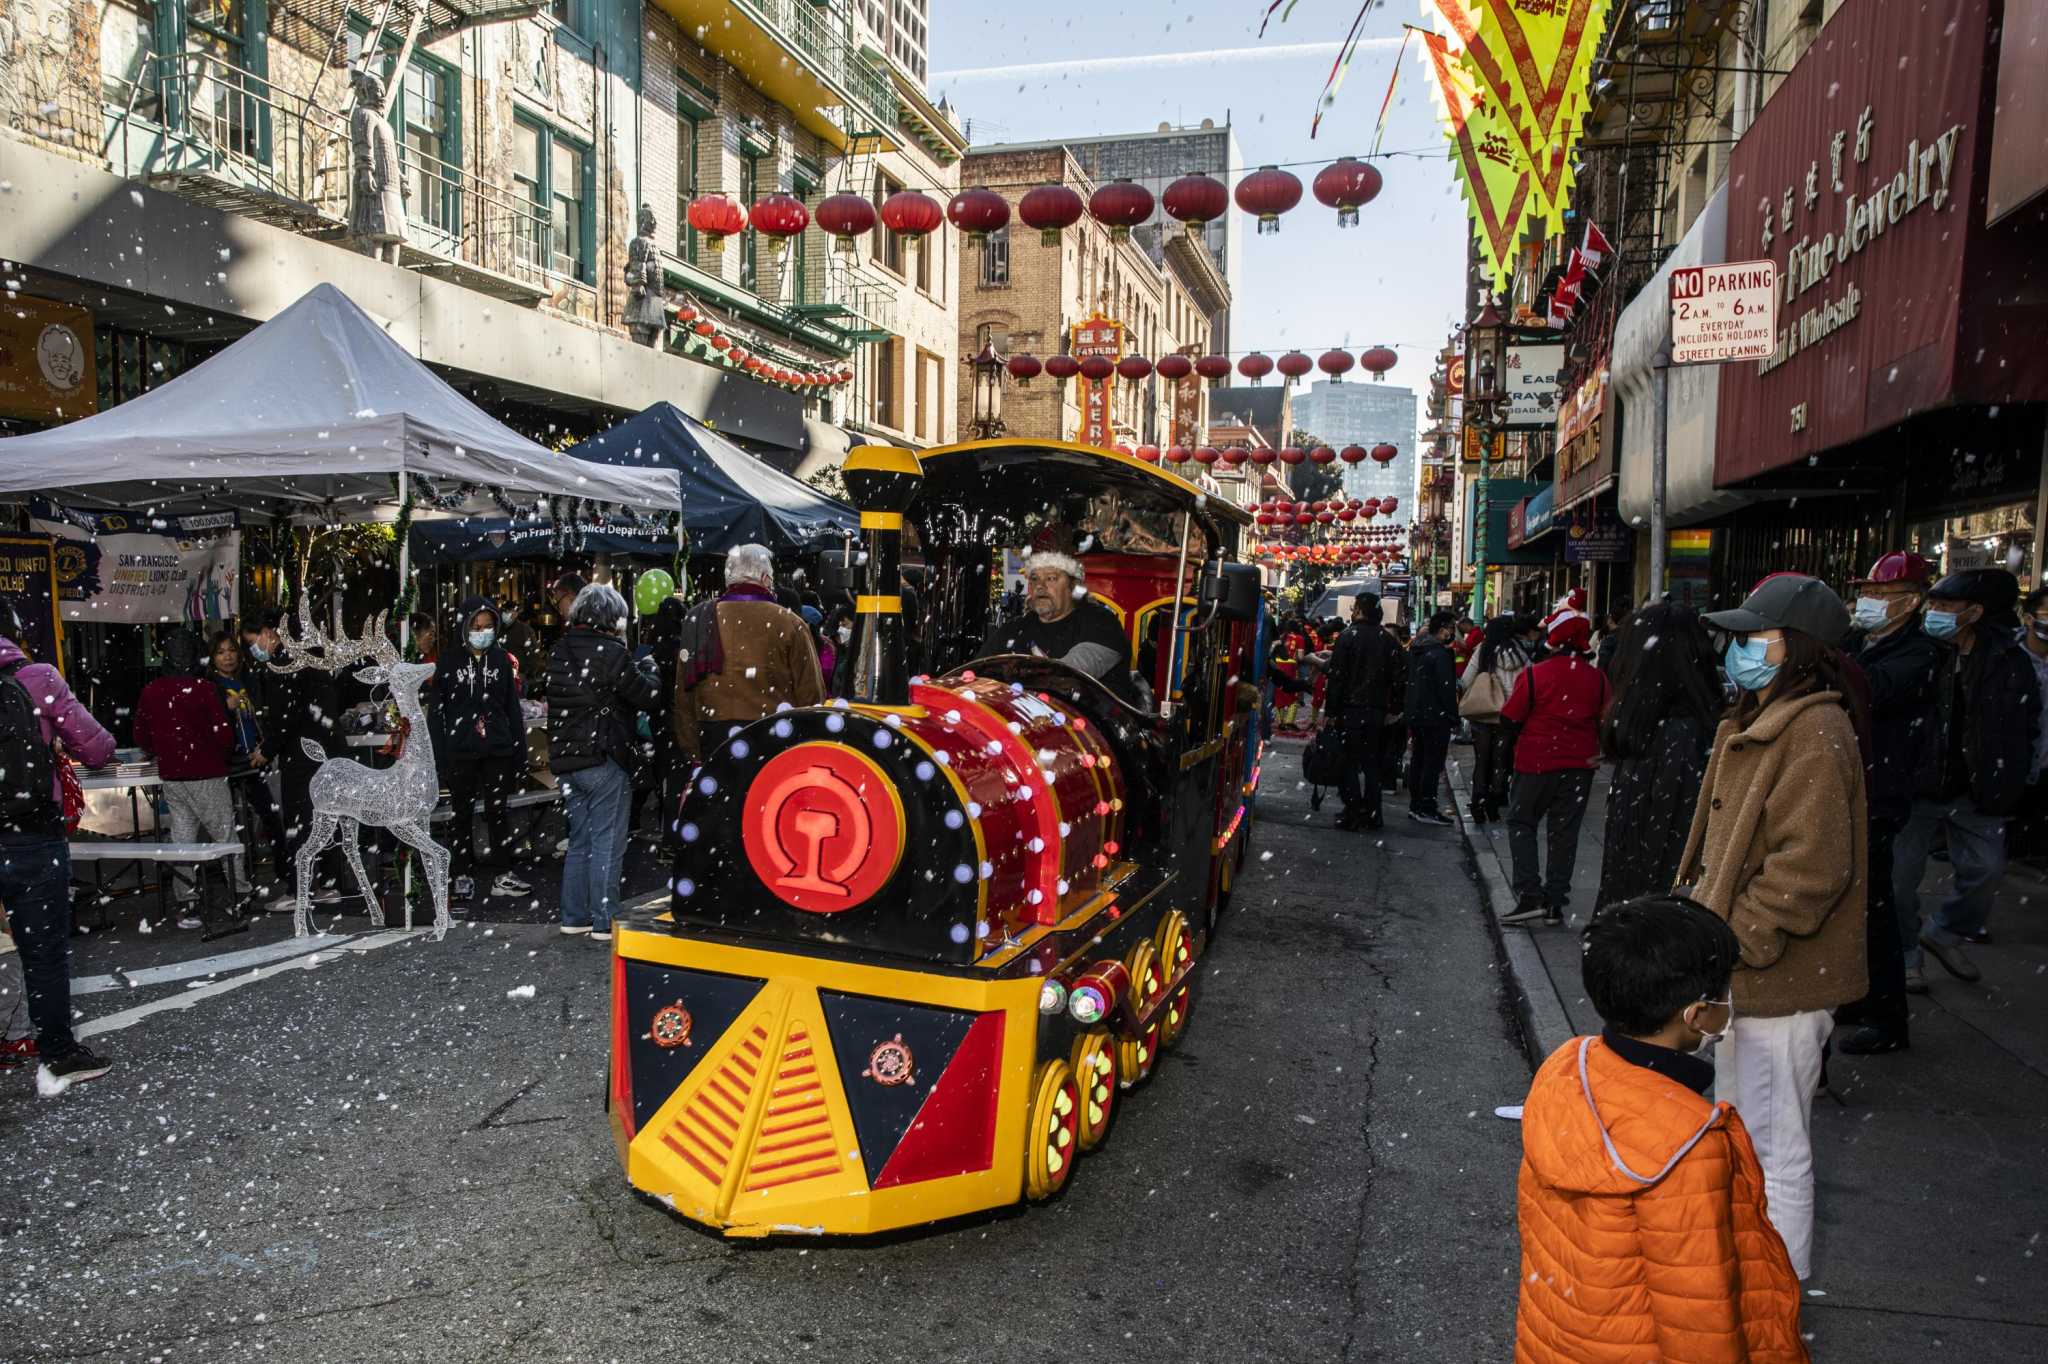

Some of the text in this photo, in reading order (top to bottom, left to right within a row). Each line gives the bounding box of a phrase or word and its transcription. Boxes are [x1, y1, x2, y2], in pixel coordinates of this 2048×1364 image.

[1786, 232, 1835, 304] Fine
[1837, 123, 1962, 265] Jewelry
[1674, 270, 1771, 297] NO PARKING
[1679, 302, 1690, 320] 2
[1692, 308, 1712, 319] A.M.
[1733, 298, 1744, 315] 6
[1747, 303, 1768, 315] A.M.
[1800, 281, 1862, 352] Wholesale
[1700, 319, 1745, 332] EVERYDAY
[1677, 328, 1769, 345] INCLUDING HOLIDAYS
[1679, 344, 1767, 360] STREET CLEANING
[1522, 375, 1555, 384] EAS
[1790, 400, 1807, 434] 750
[509, 529, 528, 543] San
[118, 554, 179, 567] SAN FRANCISCO
[113, 569, 188, 582] UNIFIED LIONS CLUB
[109, 583, 150, 595] DISTRICT
